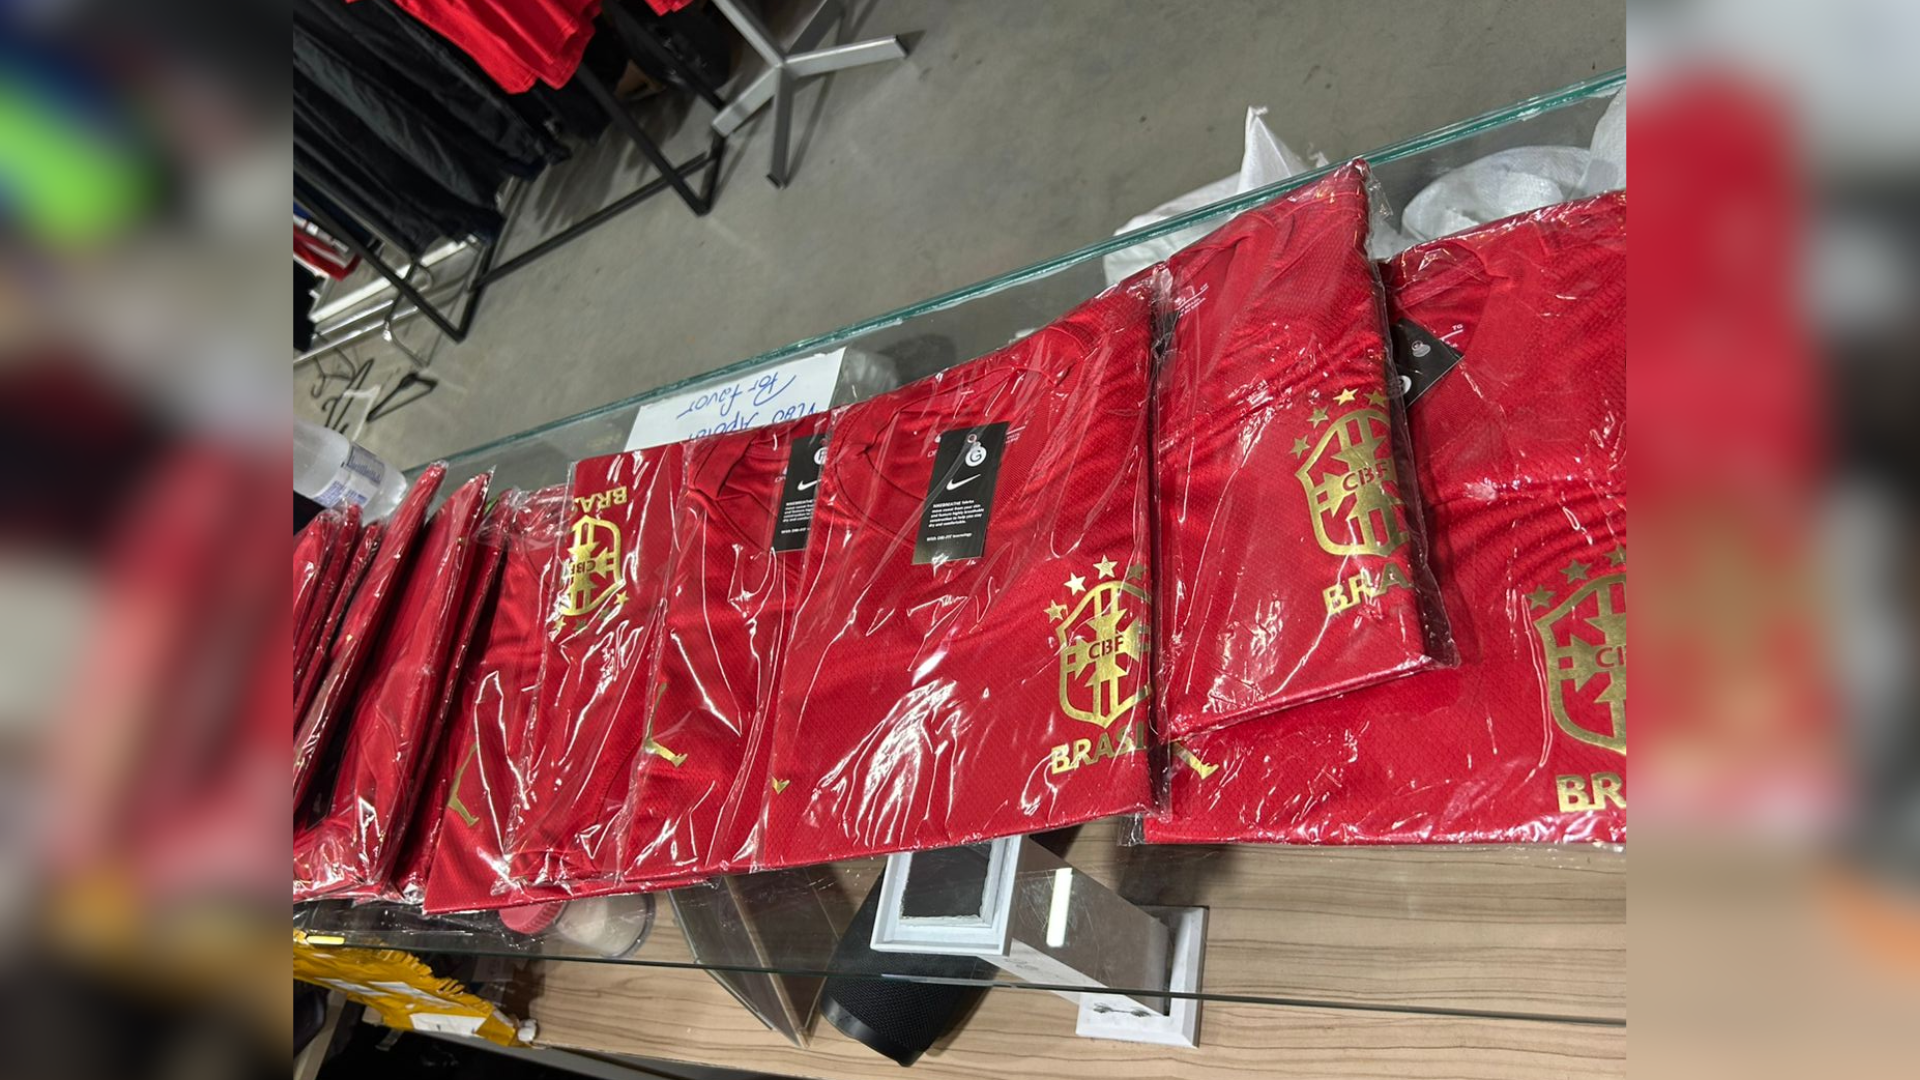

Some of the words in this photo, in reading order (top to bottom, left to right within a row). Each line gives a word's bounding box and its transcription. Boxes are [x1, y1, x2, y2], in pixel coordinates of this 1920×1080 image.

[676, 384, 742, 417] favor
[748, 372, 796, 406] Por
[1341, 461, 1388, 492] CBF
[573, 486, 628, 513] BRA
[1088, 634, 1124, 660] CBF
